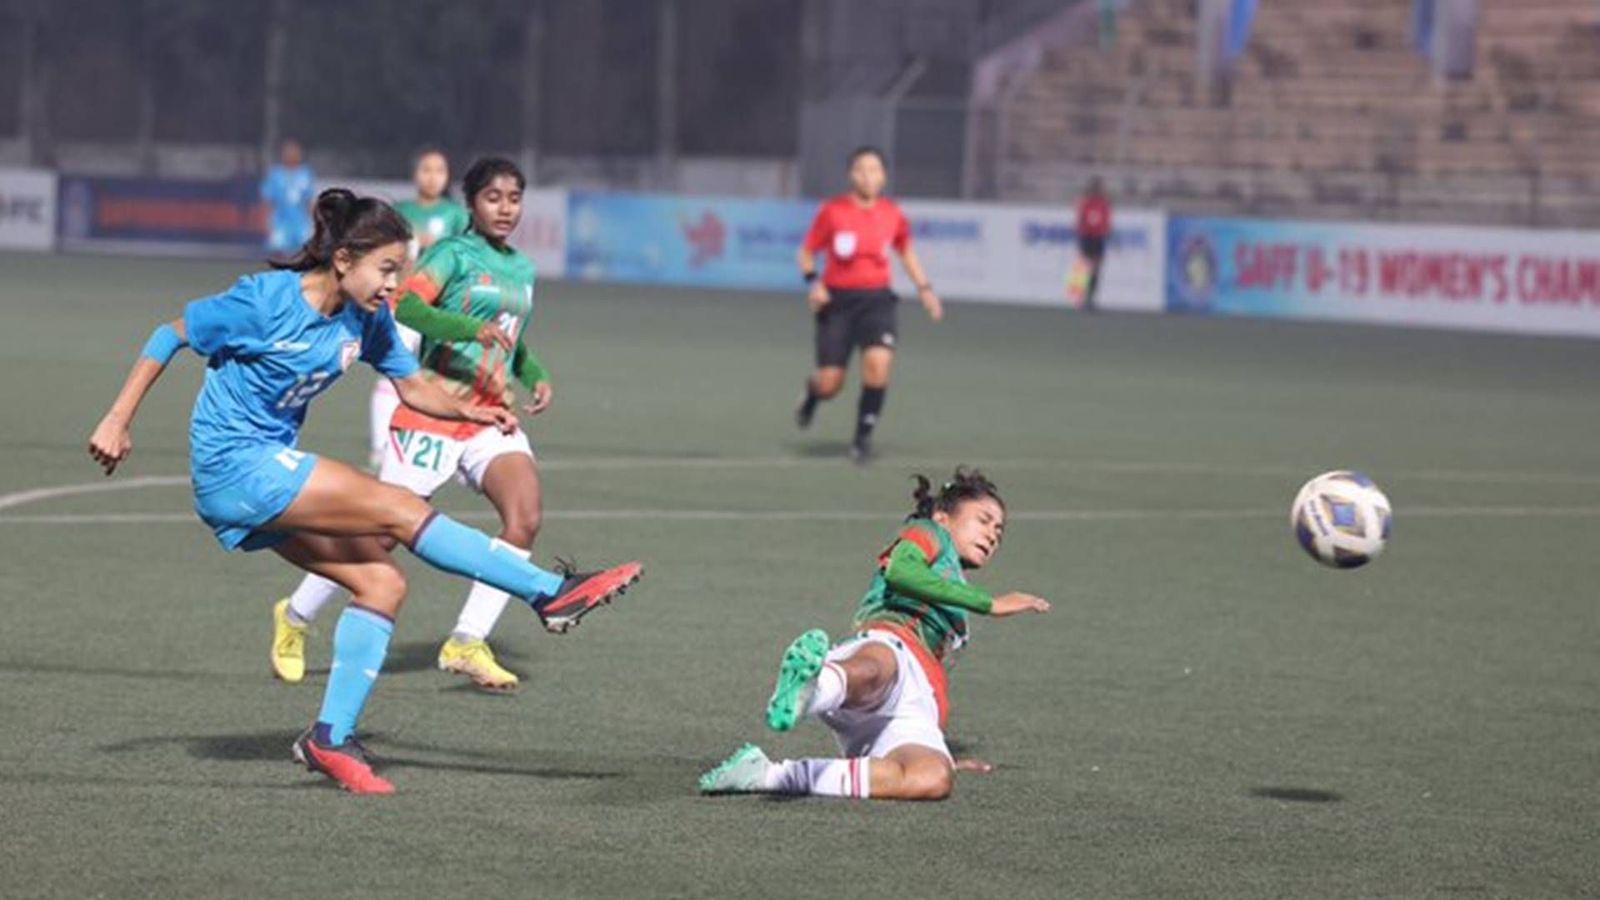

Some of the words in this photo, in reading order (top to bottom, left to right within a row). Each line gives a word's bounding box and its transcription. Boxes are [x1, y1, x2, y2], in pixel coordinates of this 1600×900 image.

[1235, 240, 1298, 290] SAFF
[1305, 244, 1369, 296] U-19
[1379, 249, 1508, 304] WOMEN'S
[412, 435, 442, 471] 21
